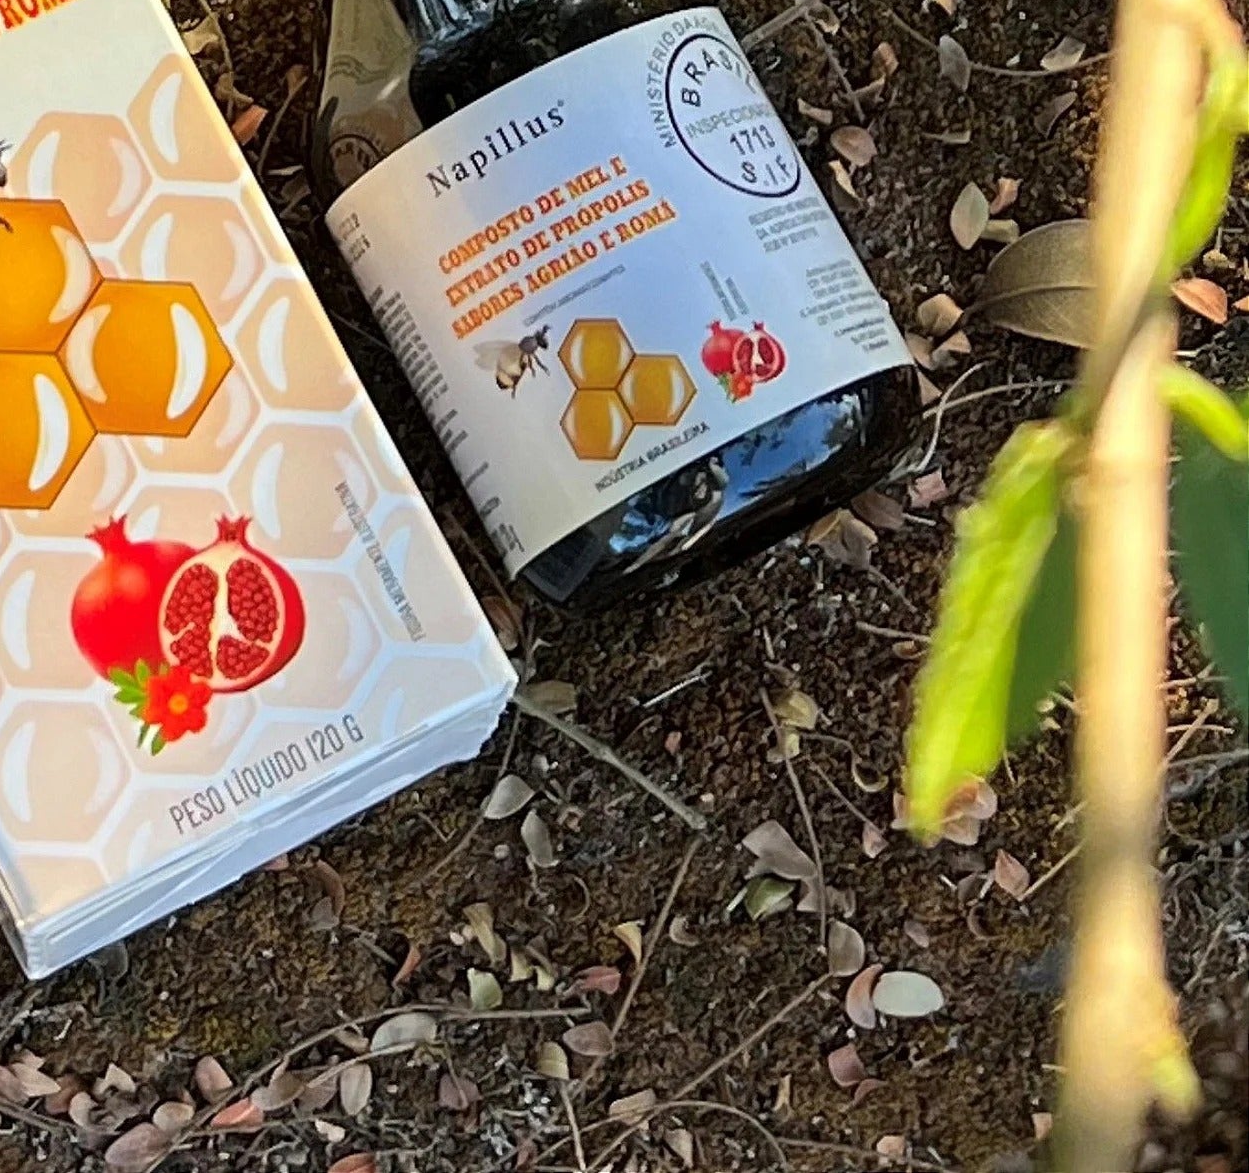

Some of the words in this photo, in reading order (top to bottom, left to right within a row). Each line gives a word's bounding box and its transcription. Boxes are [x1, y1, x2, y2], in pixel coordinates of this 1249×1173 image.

[439, 205, 535, 274] COMPOSTO
[535, 187, 566, 216] DE
[565, 165, 612, 199] MEL
[609, 155, 628, 176] E
[521, 230, 551, 260] DE
[550, 178, 651, 242] PRÓPOLIS
[451, 281, 525, 339] SABORES
[525, 241, 598, 294] AGRIÃO
[598, 229, 617, 250] E
[169, 785, 226, 835] PESO
[224, 743, 307, 807] LÍQUIDO
[305, 724, 344, 763] 120
[342, 713, 364, 743] G
